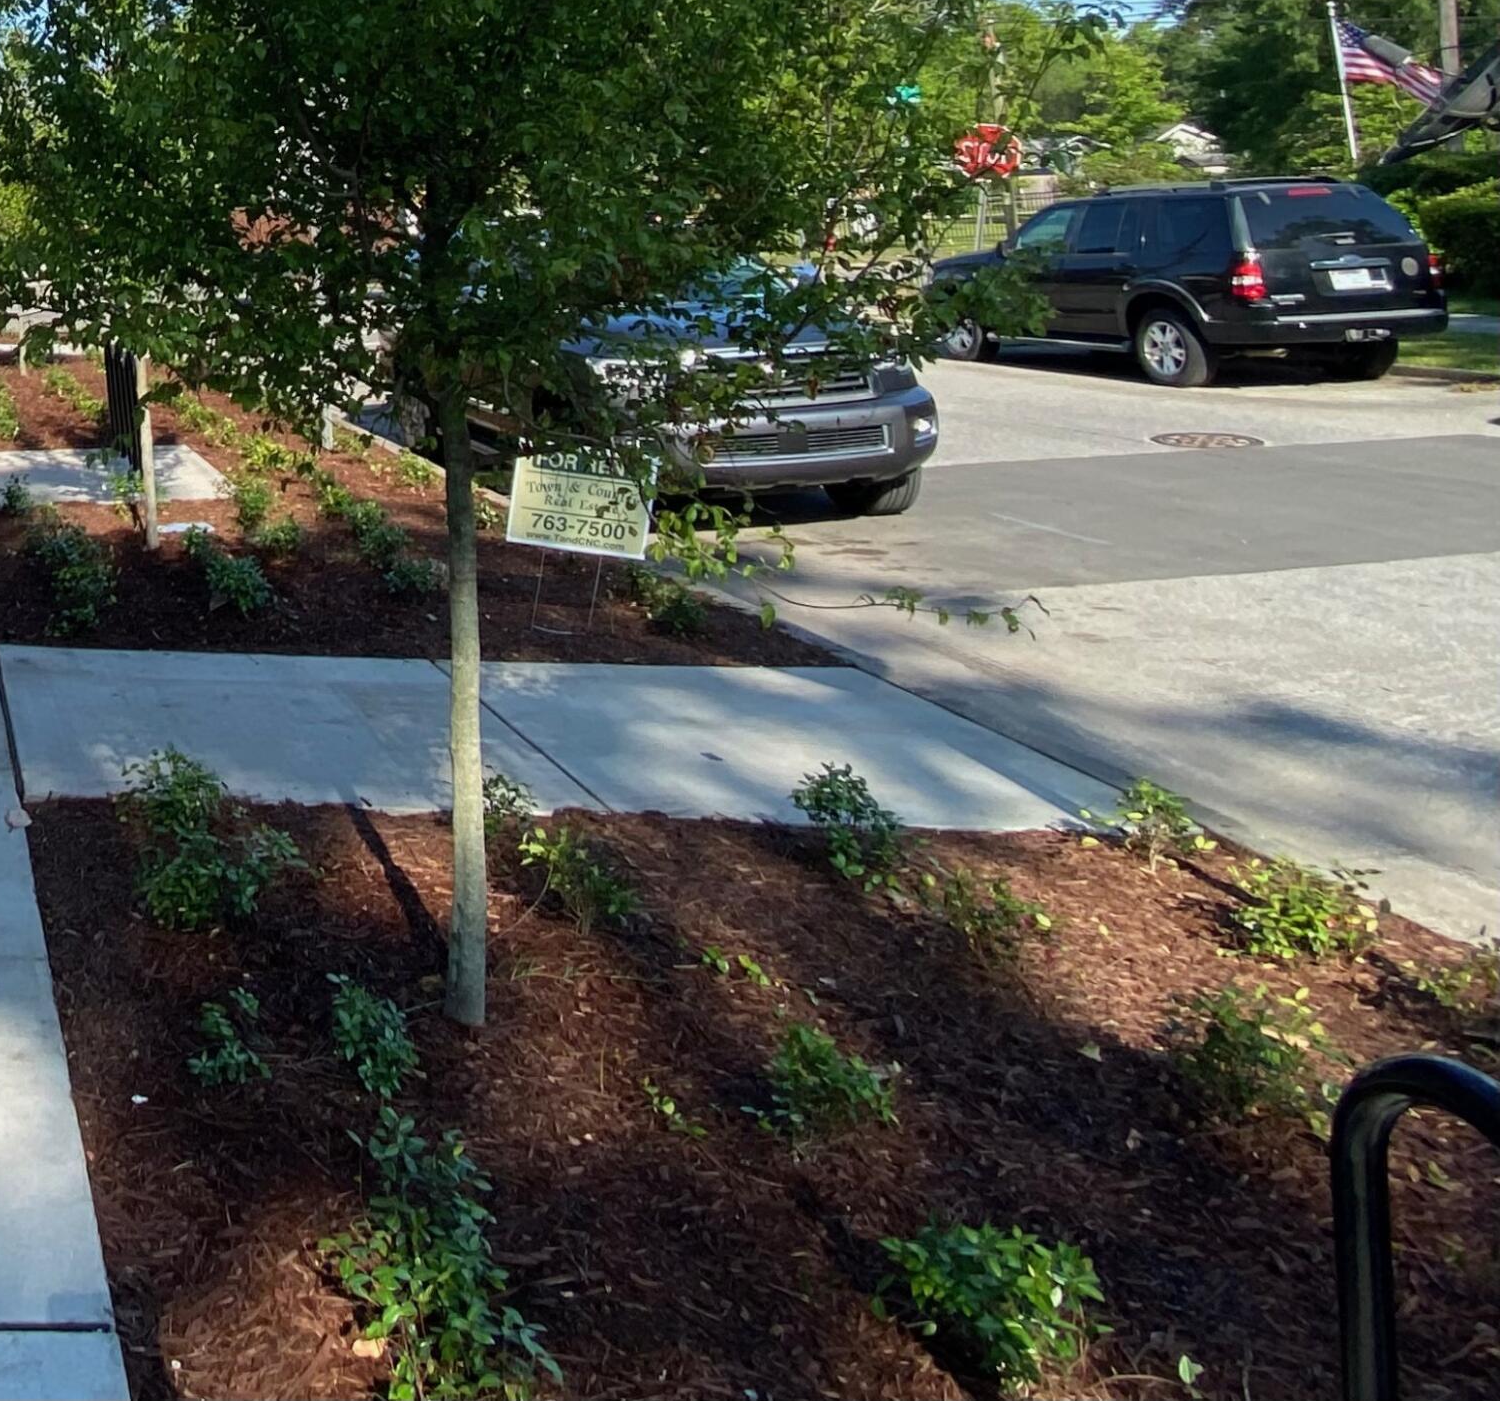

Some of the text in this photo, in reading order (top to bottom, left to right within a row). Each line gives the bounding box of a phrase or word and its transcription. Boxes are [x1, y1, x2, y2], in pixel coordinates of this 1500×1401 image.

[537, 452, 578, 471] FOR
[527, 480, 562, 495] Town
[569, 481, 580, 494] &
[544, 495, 573, 508] Real
[531, 513, 625, 540] 763-7500
